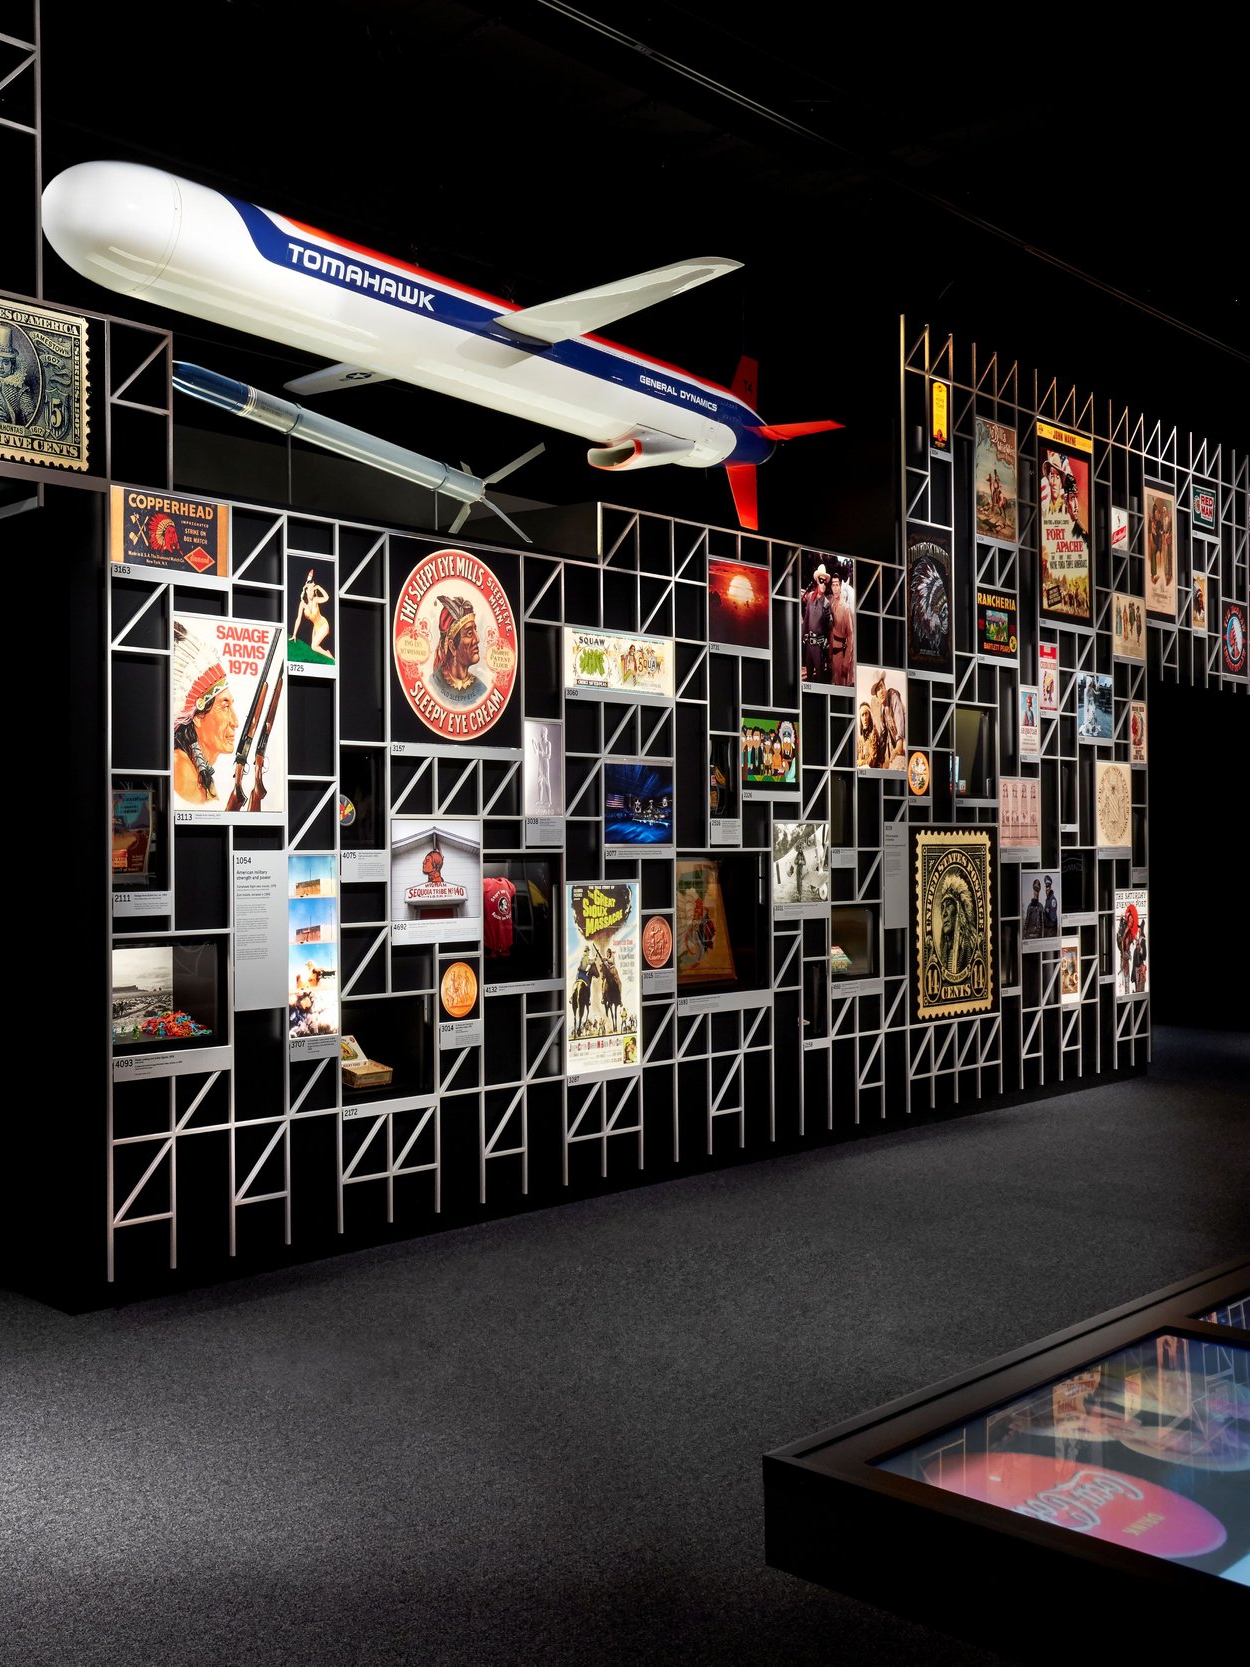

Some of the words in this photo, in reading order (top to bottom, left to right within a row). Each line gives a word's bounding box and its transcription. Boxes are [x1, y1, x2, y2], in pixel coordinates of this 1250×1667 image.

[287, 241, 436, 312] TOMAHAWK
[13, 310, 28, 325] OF
[26, 312, 80, 337] AMERICA
[32, 332, 71, 356] JAMESTOWN
[639, 373, 678, 397] GENERAL
[679, 389, 718, 413] DYNAMICS
[50, 399, 63, 429] 5
[0, 432, 31, 450] FIVE
[32, 437, 79, 458] CENTS
[127, 493, 215, 520] COPPERHEAD
[1200, 495, 1213, 508] RED
[1201, 505, 1213, 518] MAN
[1045, 527, 1066, 541] FORT
[1055, 540, 1084, 554] APACHE
[113, 564, 131, 575] 3163
[437, 555, 456, 578] EYE
[408, 560, 439, 602] SLEEPY
[485, 576, 507, 611] SLEEPY
[977, 592, 1017, 611] RANCHERIA
[399, 594, 419, 625] THE
[487, 594, 504, 628] MINN.
[215, 624, 270, 645] SAVAGE
[578, 635, 606, 647] SQUAW
[222, 642, 266, 661] ARMS
[228, 659, 259, 677] 1979
[289, 663, 305, 673] 3725
[566, 689, 579, 697] 3060
[409, 680, 448, 728] SLEEPY
[447, 713, 469, 735] EYE
[468, 687, 506, 732] CREAM
[176, 812, 193, 822] 3113
[235, 856, 252, 865] 1054
[939, 852, 967, 874] STATES
[113, 893, 132, 903] 2111
[593, 888, 616, 908] GREAT
[582, 898, 608, 918] SIOUX
[393, 923, 407, 931] 4692
[585, 909, 623, 938] MASSACRE
[927, 968, 940, 995] 14
[972, 963, 985, 990] 14
[485, 985, 498, 994] 4132
[940, 984, 972, 1000] CENTS
[290, 1040, 306, 1049] 3707
[115, 1058, 133, 1069] 4093
[344, 1108, 358, 1117] 2172
